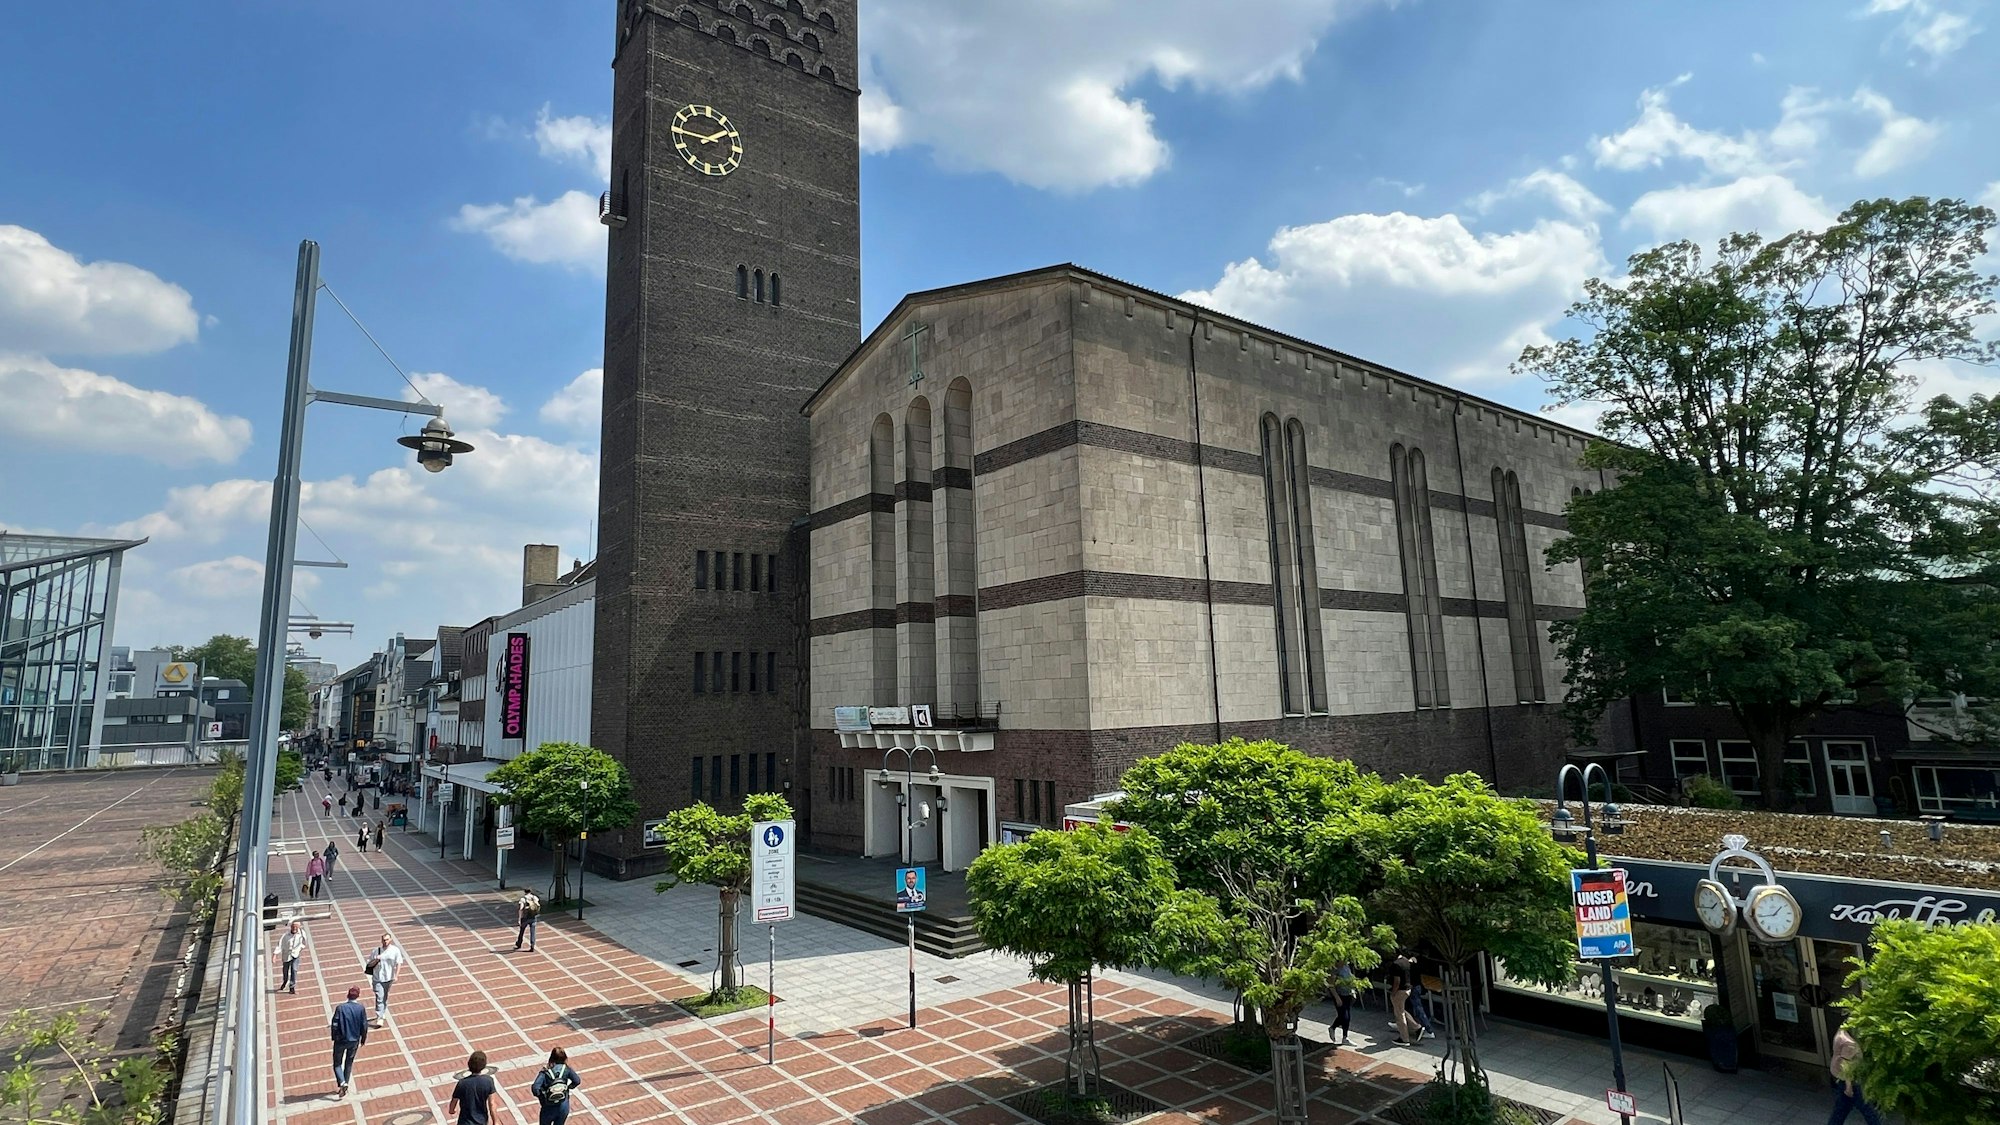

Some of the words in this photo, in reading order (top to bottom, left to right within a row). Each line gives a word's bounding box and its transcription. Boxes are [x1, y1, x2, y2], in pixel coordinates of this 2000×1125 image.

[1577, 890, 1614, 905] UNSER
[1579, 906, 1611, 921] LAND
[1583, 919, 1627, 936] ZUERST!
